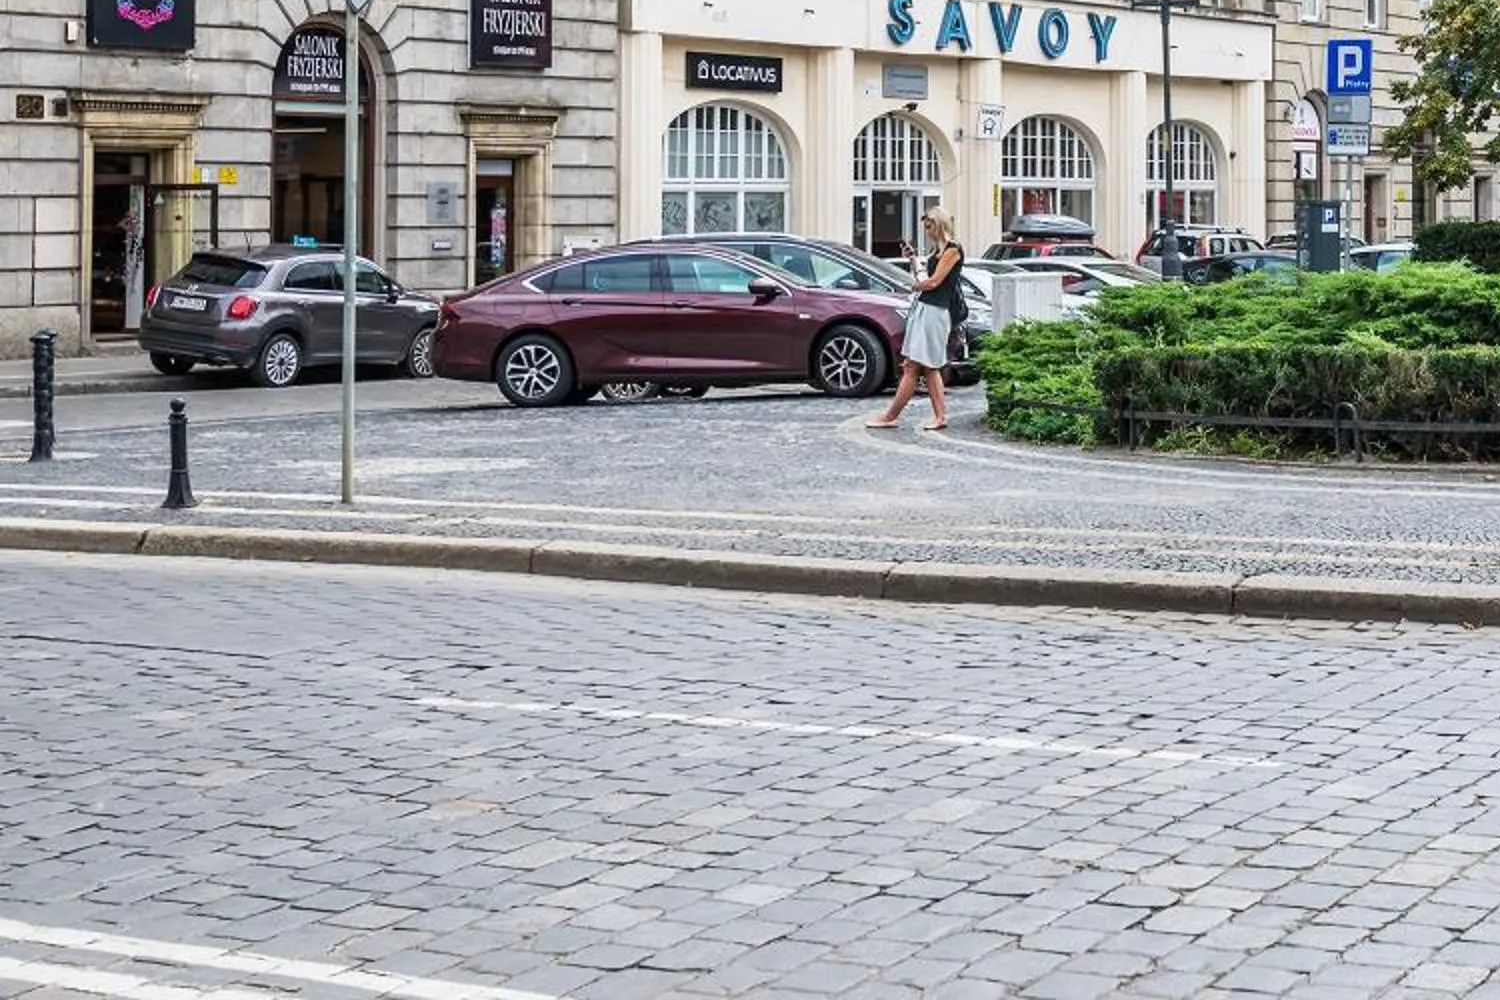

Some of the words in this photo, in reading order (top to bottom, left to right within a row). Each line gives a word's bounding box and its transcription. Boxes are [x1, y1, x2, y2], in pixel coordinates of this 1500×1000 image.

[482, 7, 546, 41] FRYZJERSKI
[293, 33, 340, 56] SALONIK
[287, 55, 343, 81] FRYZJERSKI
[711, 64, 777, 83] LOCATIVUS
